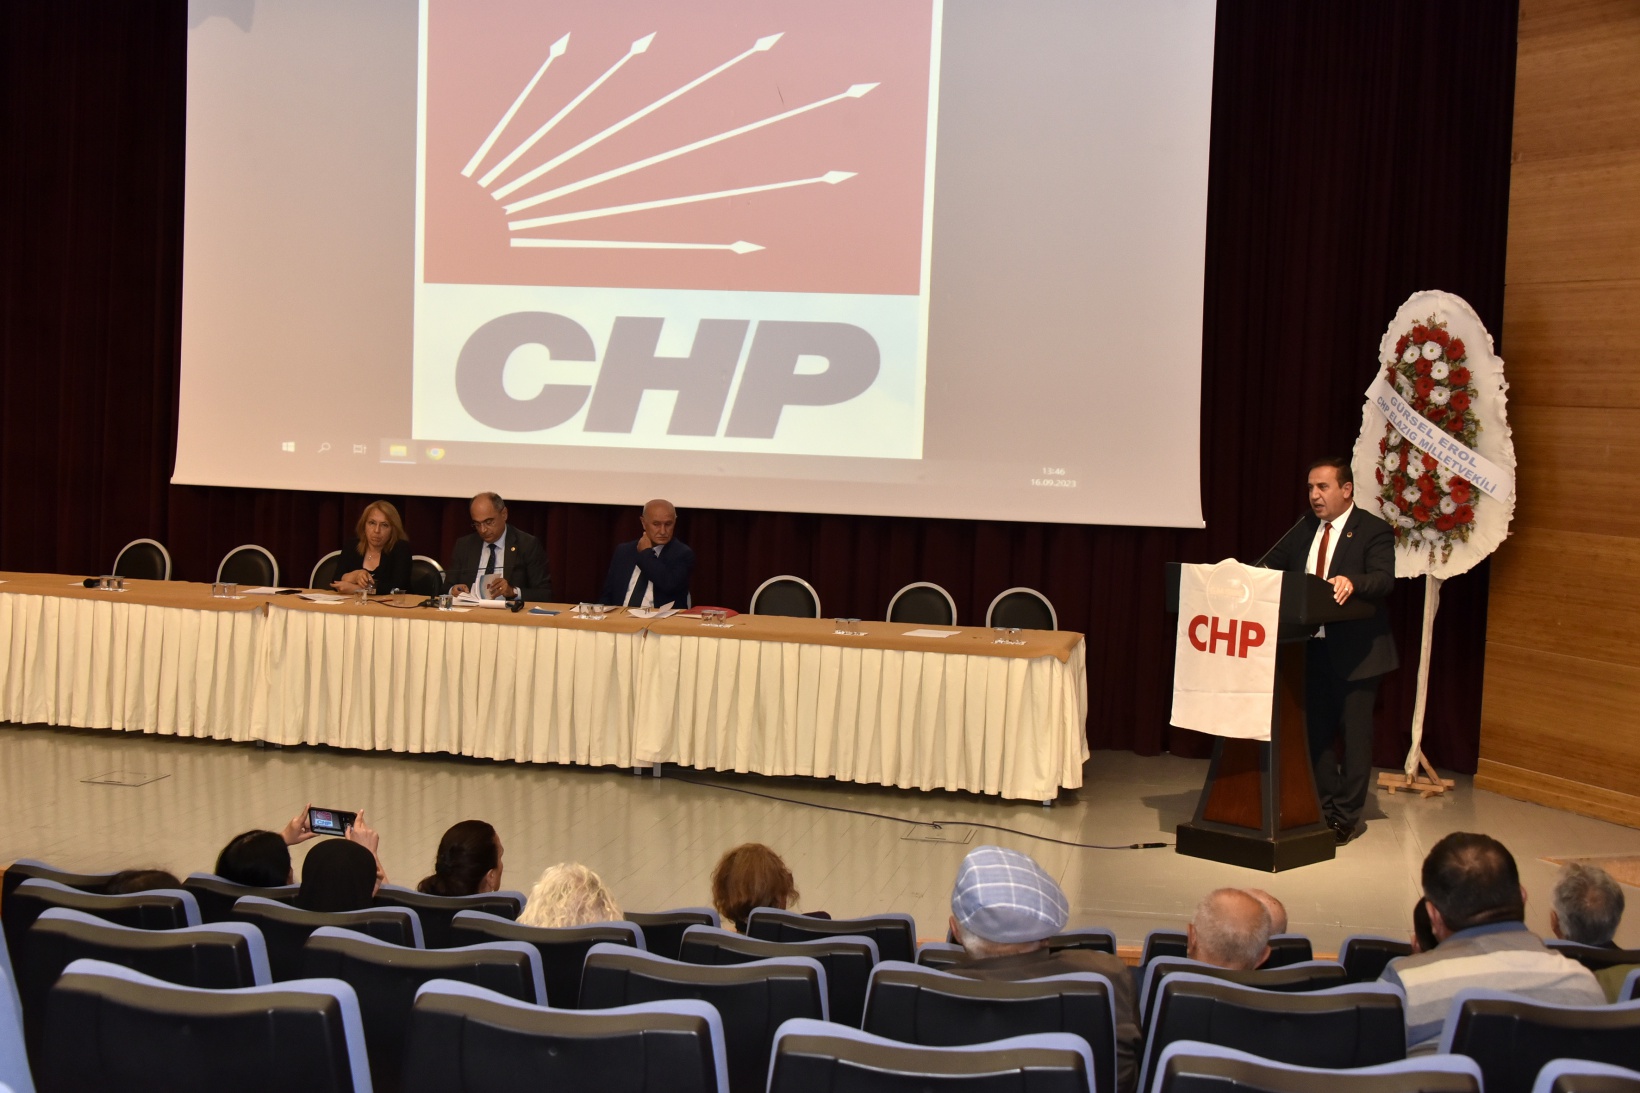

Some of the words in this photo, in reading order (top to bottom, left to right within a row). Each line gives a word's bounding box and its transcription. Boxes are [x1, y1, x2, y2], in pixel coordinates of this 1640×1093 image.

[455, 311, 881, 439] CHP
[1377, 396, 1390, 412] CHP
[1418, 437, 1497, 494] MİLLETVEKİLİ
[1390, 396, 1434, 439] GÜRSEL
[1438, 437, 1477, 468] EROL
[1042, 467, 1066, 476] 13:46
[1188, 614, 1266, 659] CHP
